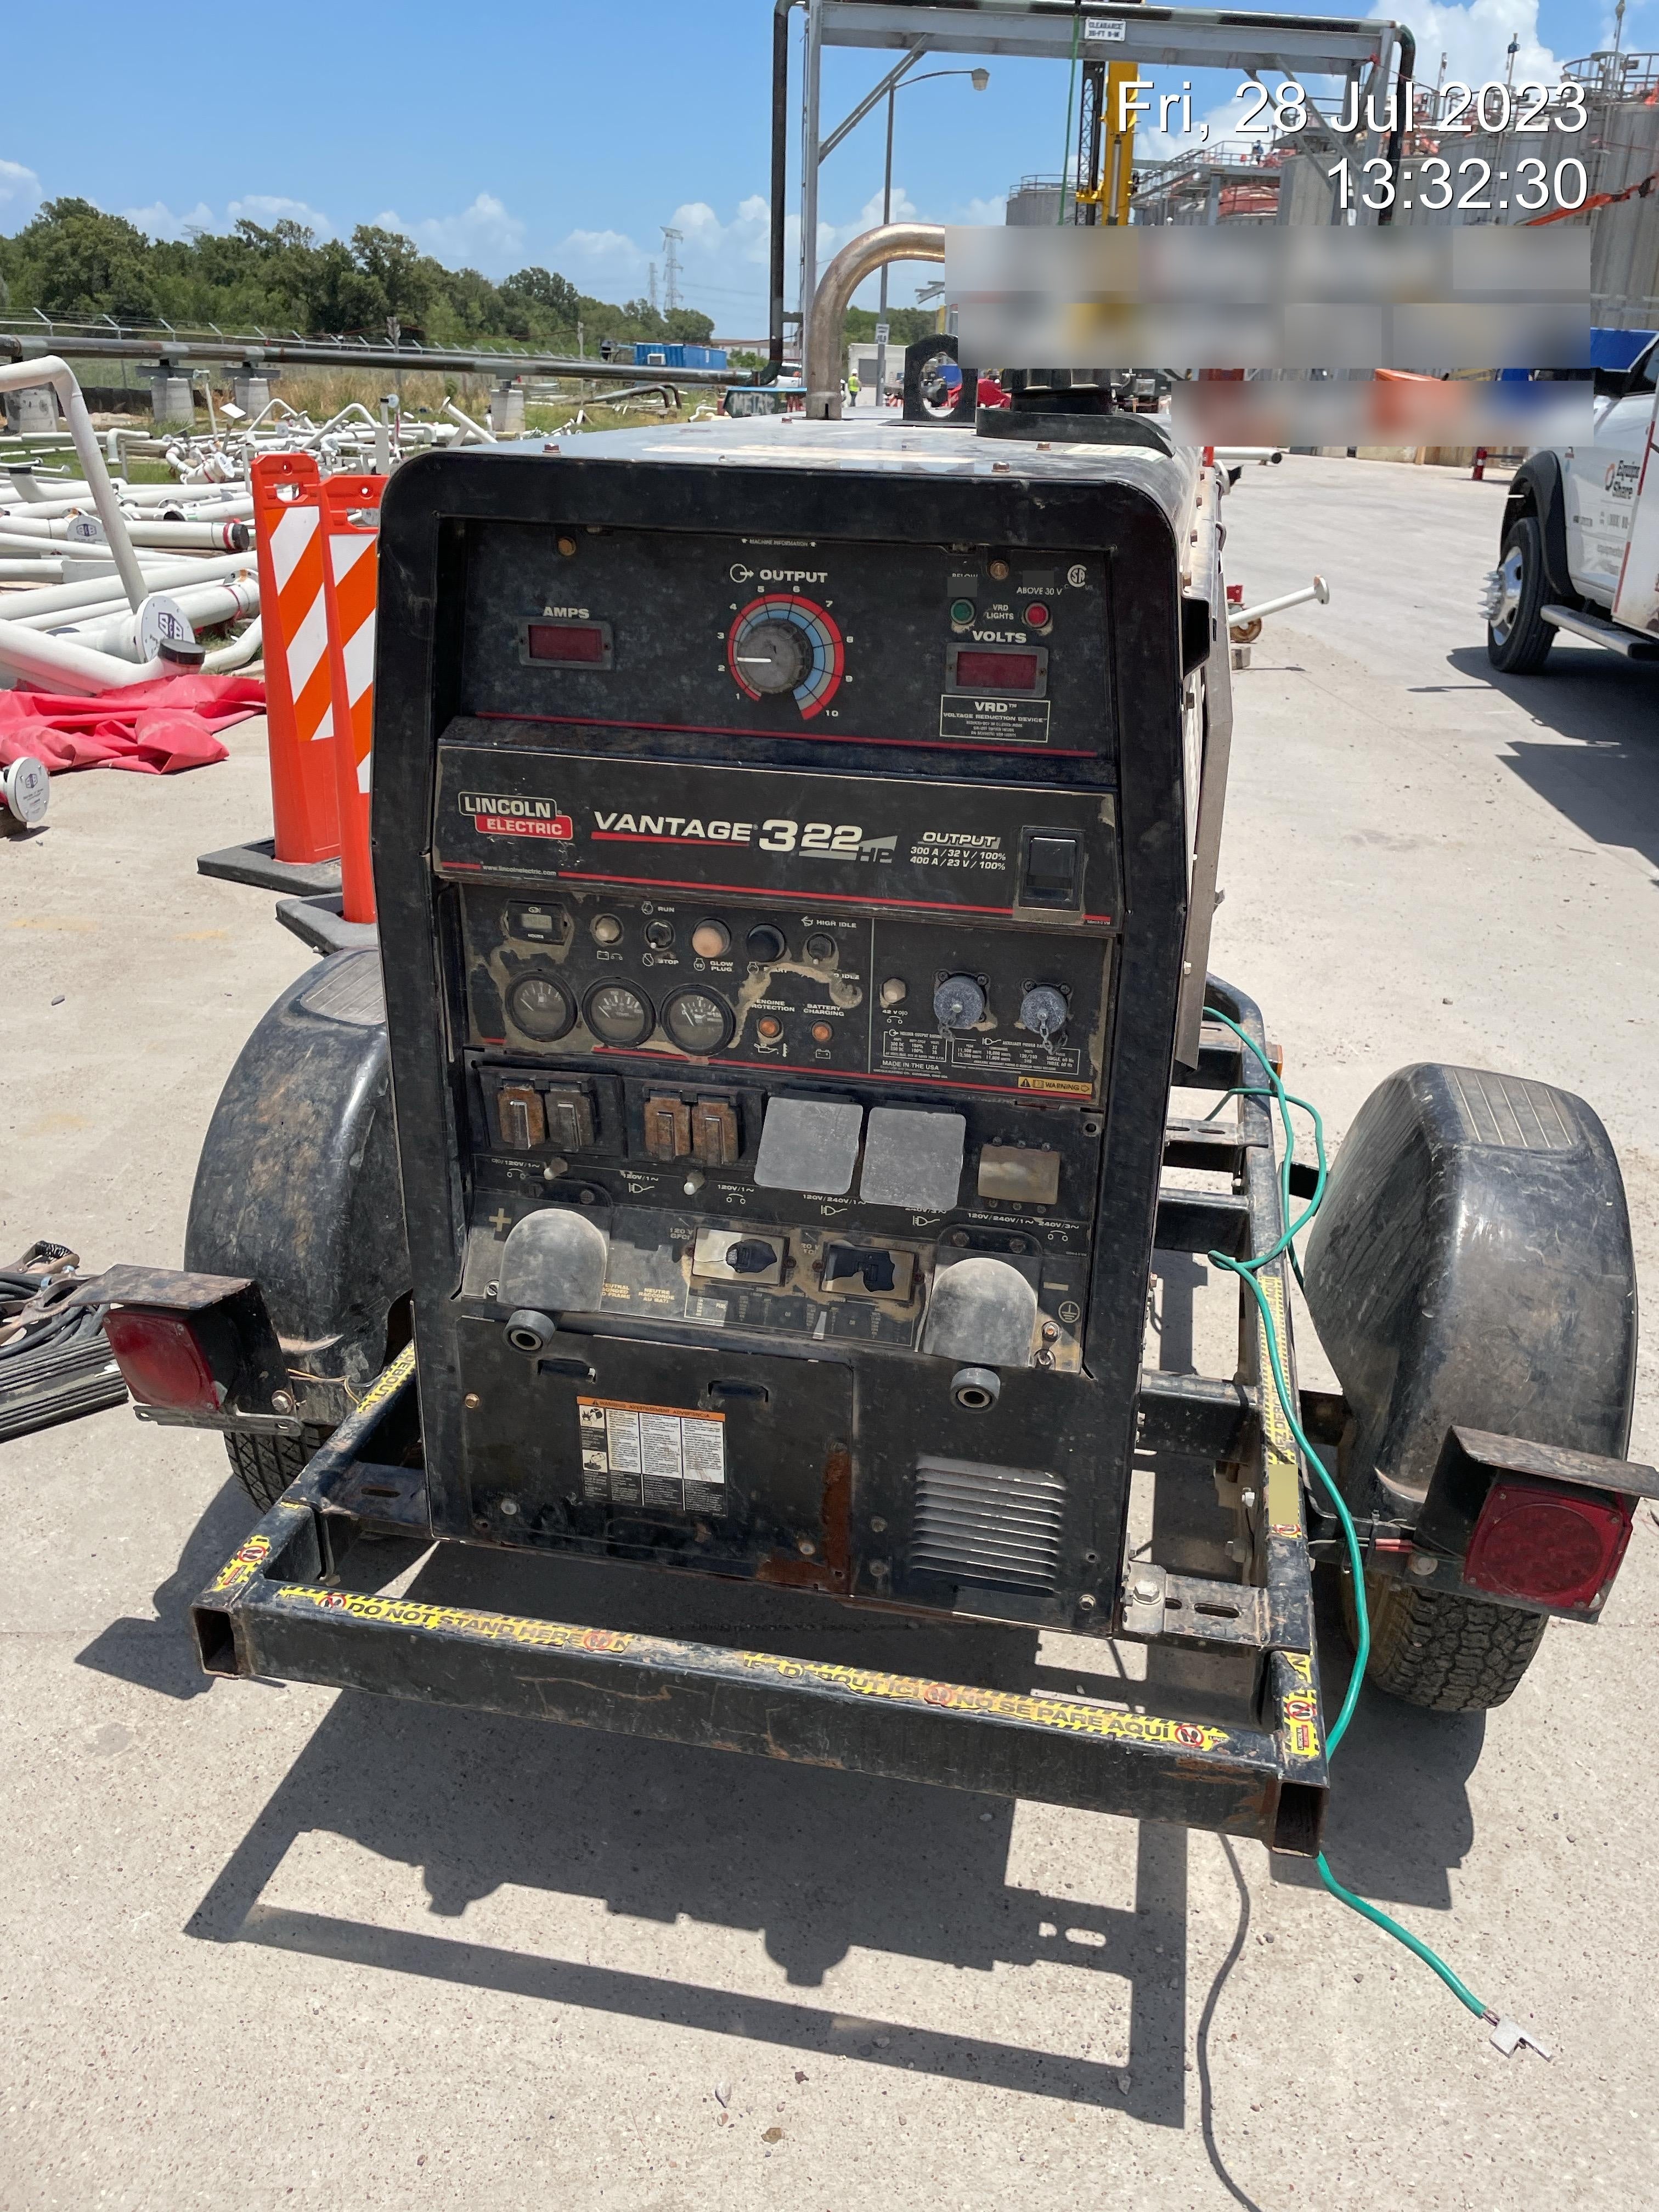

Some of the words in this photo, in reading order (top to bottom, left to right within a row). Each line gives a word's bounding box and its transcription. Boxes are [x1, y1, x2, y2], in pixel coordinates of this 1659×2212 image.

[759, 569, 828, 583] OUTPUT
[1016, 586, 1043, 595] ABOVE
[1045, 587, 1054, 595] 30
[543, 606, 590, 619] AMPS
[986, 612, 1014, 620] LIGHTS
[973, 630, 1027, 644] VOLTS
[464, 796, 551, 818] LINCOLN
[486, 818, 563, 836] ELECTRIC
[594, 810, 751, 842] VANTAGE
[758, 819, 863, 853] 322
[922, 832, 996, 847] OUTPUT
[910, 846, 930, 855] 300
[947, 849, 960, 857] 32
[980, 851, 1006, 861] 100%
[482, 865, 557, 876] www.lincolnelectric.com
[910, 856, 930, 865] 400
[963, 860, 970, 868] V
[979, 861, 1006, 871] 100%
[816, 919, 837, 928] HIGH
[751, 1004, 795, 1012] ROTECTION
[803, 1008, 845, 1017] CHARGING
[1045, 1081, 1080, 1091] WARNING
[347, 1602, 383, 1616] DO
[385, 1607, 436, 1624] NOT
[439, 1615, 515, 1634] STAND
[517, 1626, 584, 1645] HERE
[956, 1693, 995, 1709] NO
[998, 1701, 1032, 1716] SE
[1036, 1705, 1104, 1726] PARE
